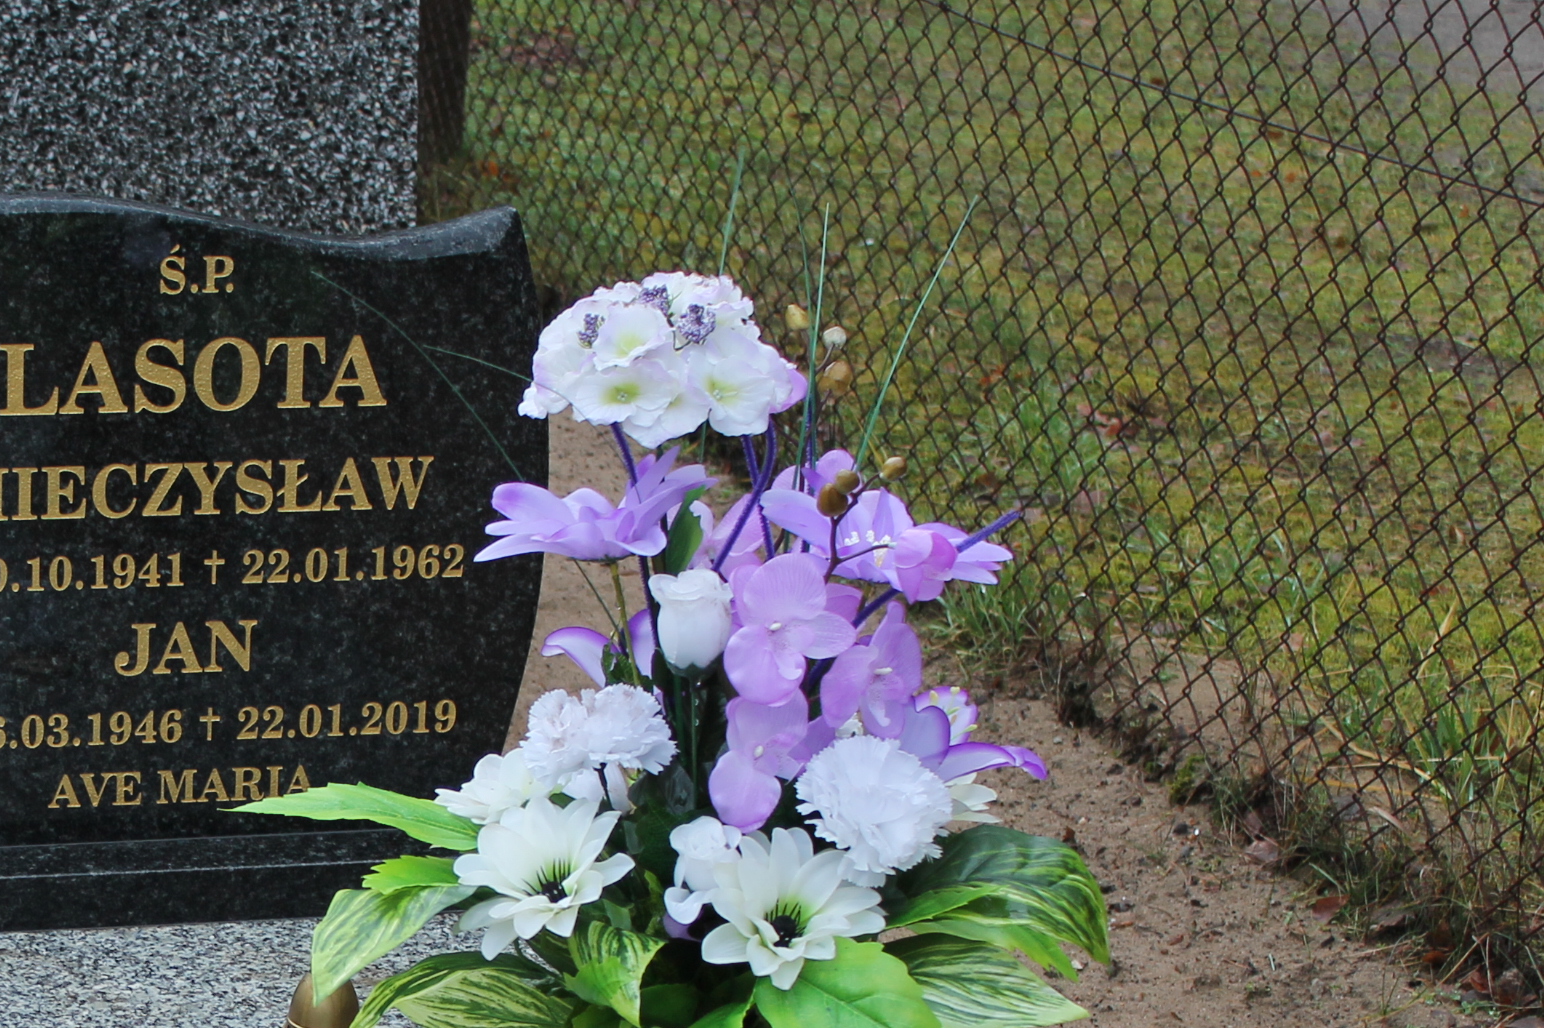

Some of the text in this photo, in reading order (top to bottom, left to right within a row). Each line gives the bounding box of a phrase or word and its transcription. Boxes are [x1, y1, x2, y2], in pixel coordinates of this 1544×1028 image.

[159, 244, 235, 295] Ś.P.
[241, 543, 465, 584] 22.01.1962
[113, 619, 258, 677] JAN
[236, 699, 457, 741] 22.01.2019
[48, 764, 311, 808] AVE MARIA
